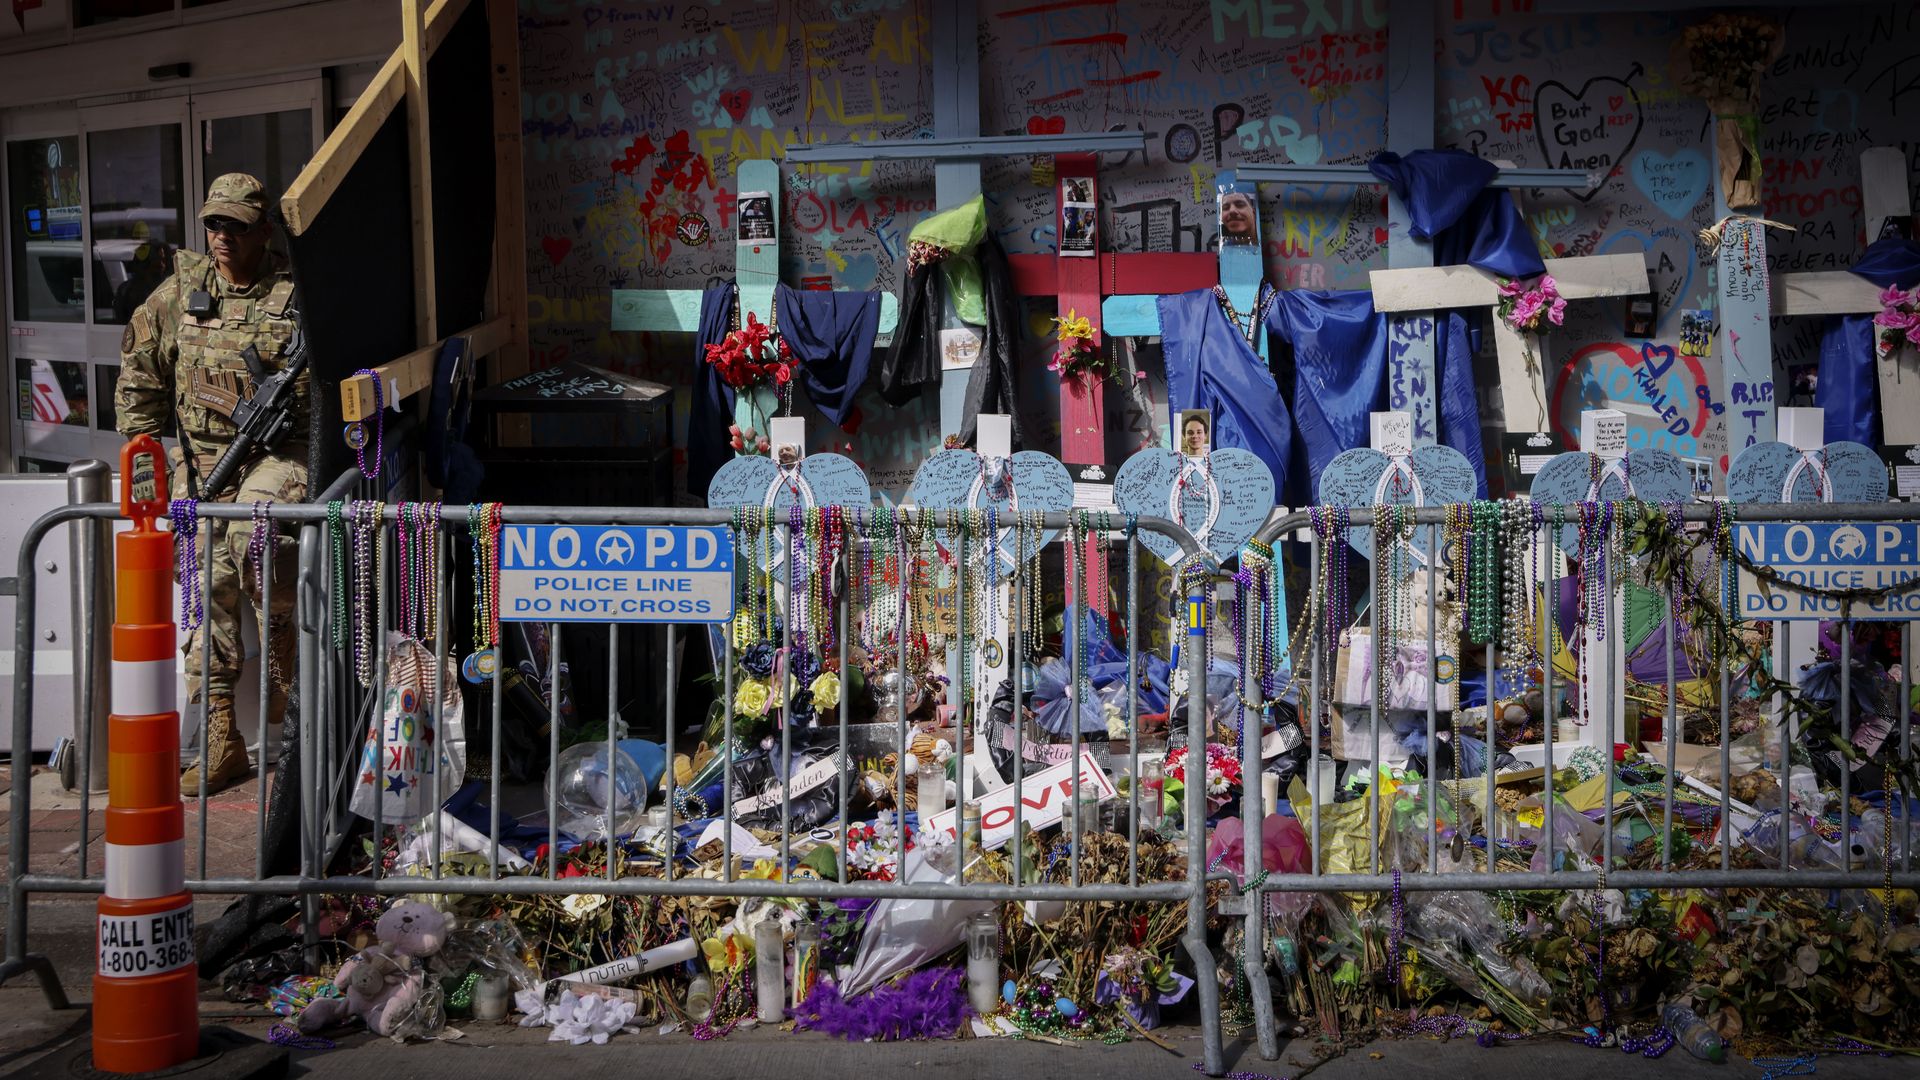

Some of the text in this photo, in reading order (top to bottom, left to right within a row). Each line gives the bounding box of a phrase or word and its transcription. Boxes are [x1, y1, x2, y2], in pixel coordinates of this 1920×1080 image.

[647, 4, 675, 21] NY
[1211, 0, 1387, 43] MEXIC
[723, 15, 932, 74] WE AR
[805, 74, 907, 125] ALL
[1552, 101, 1591, 120] But
[1560, 151, 1611, 171] Amen
[1393, 317, 1433, 341] RIP
[501, 366, 565, 392] THERE
[1622, 364, 1673, 427] KHALED
[503, 527, 728, 569] N.O. P.D.
[1738, 524, 1920, 563] N.O. P.
[534, 577, 692, 593] POLICE LINE
[1876, 570, 1920, 588] LIN
[514, 598, 711, 614] DO NOT CROSS
[1746, 593, 1920, 612] DO NO CRO
[101, 906, 194, 948] CALL ENTE
[101, 941, 195, 973] 1-800-368-
